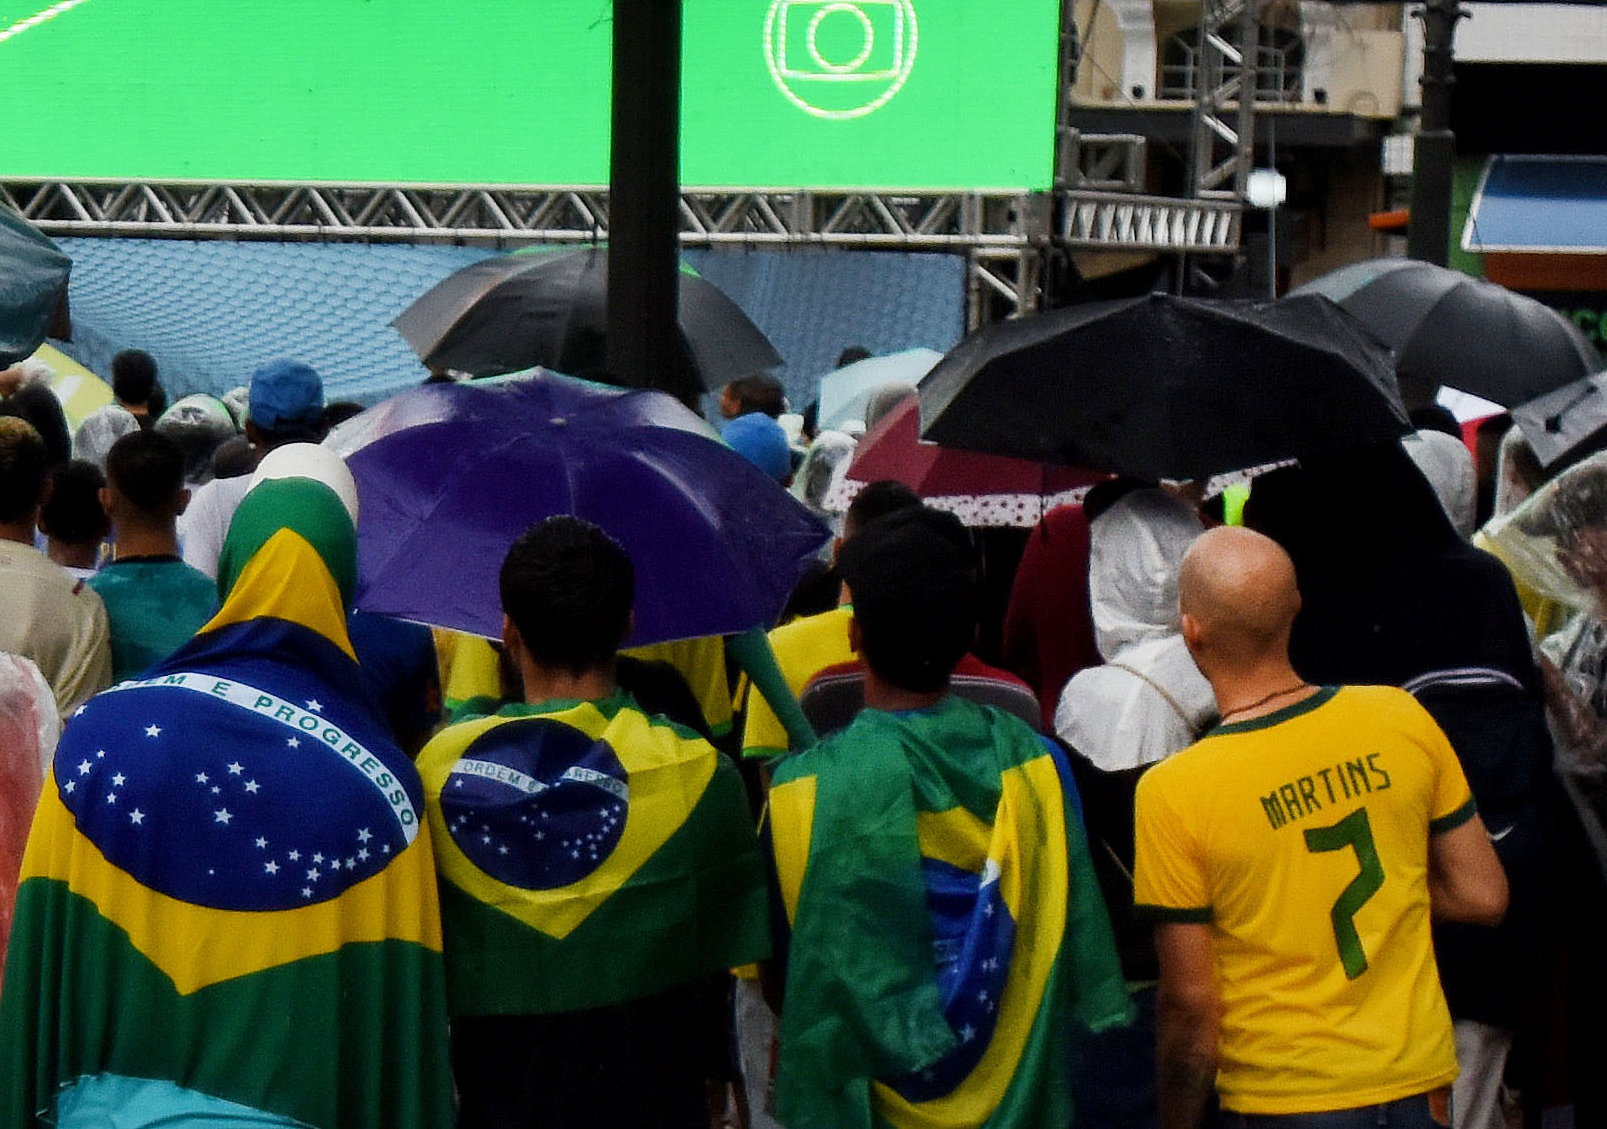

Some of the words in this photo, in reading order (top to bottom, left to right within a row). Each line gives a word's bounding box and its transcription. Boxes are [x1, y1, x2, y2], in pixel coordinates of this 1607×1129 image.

[211, 681, 231, 697] E
[253, 694, 415, 827] PROGRESSO
[463, 760, 521, 785] ORDEM
[1260, 752, 1392, 831] MARTINS
[1302, 806, 1386, 982] 7
